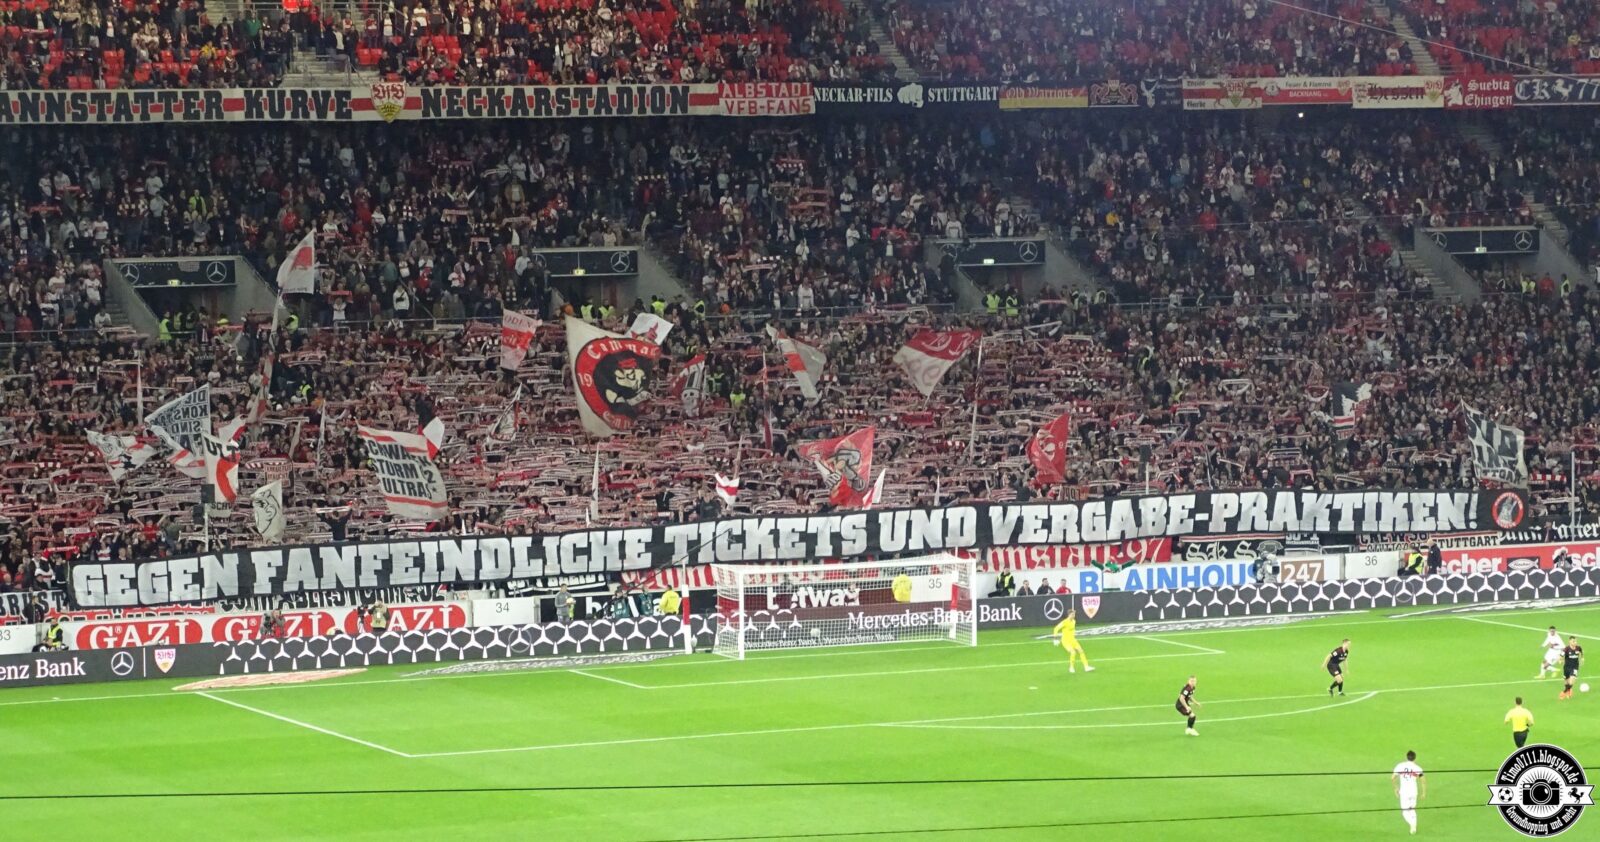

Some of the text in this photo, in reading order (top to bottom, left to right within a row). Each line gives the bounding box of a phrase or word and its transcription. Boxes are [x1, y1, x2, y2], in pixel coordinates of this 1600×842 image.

[722, 81, 812, 98] ALBSTADT
[1027, 86, 1074, 100] Warriors
[1467, 79, 1510, 91] Suebia
[421, 85, 690, 118] NECKARSTADION
[813, 86, 999, 103] NECKAR-FILS STUTTGART
[1289, 90, 1322, 98] BACKNANG
[1464, 93, 1512, 107] Ehingen
[244, 89, 352, 121] KURVE
[724, 98, 812, 115] VFB-FANS
[73, 553, 239, 607] GEGEN
[251, 528, 652, 594] FANFEINDLICHE
[665, 514, 867, 565] TICKETS
[879, 506, 976, 551] UND
[989, 491, 1478, 545] VERGABE-PRAKTIKEN!
[1365, 556, 1378, 567] 36
[1283, 563, 1322, 582] 247
[928, 578, 943, 590] 35
[495, 602, 510, 614] 34
[979, 603, 1022, 622] Bank
[35, 656, 87, 678] Bank
